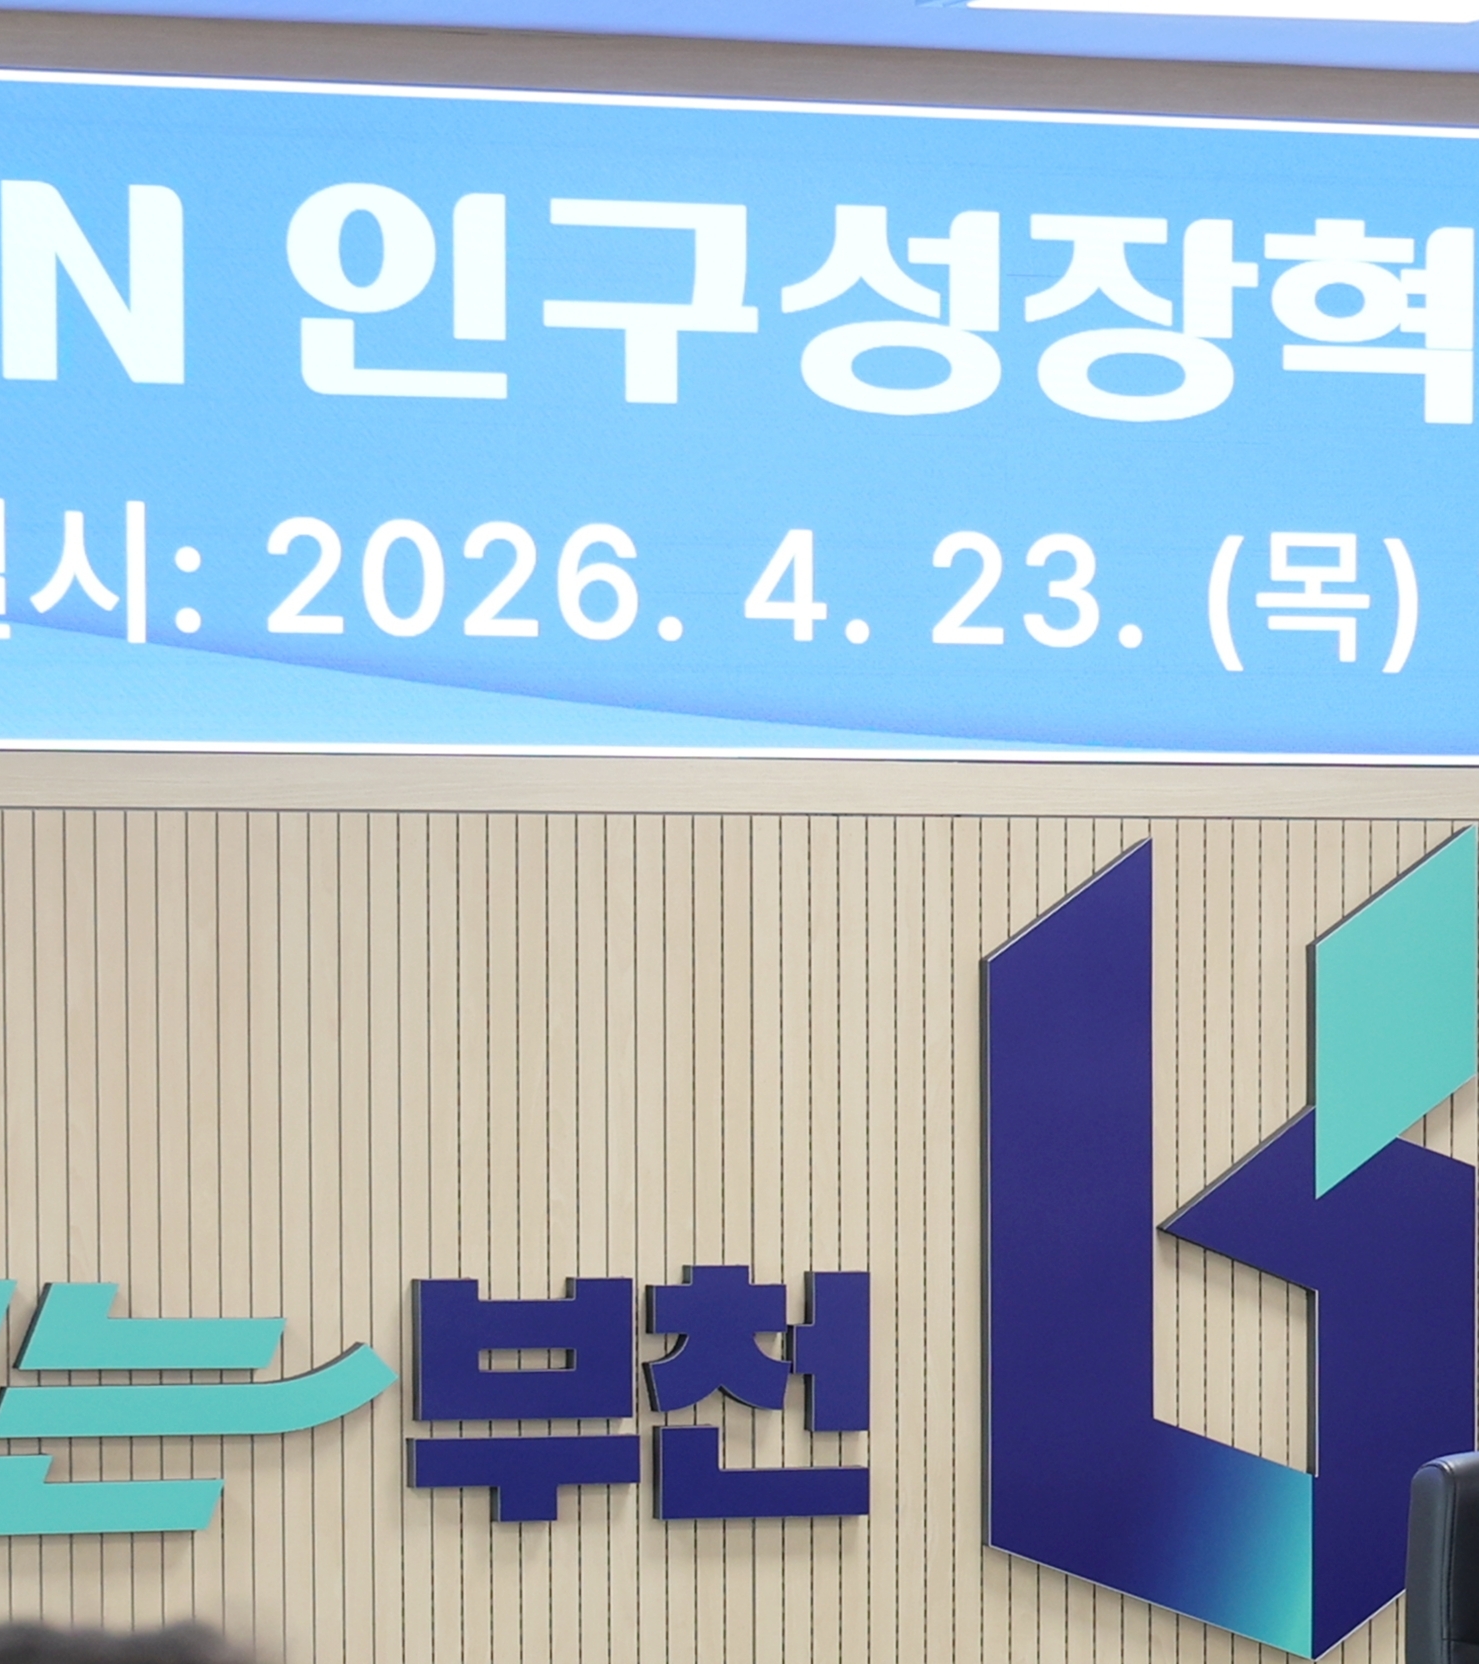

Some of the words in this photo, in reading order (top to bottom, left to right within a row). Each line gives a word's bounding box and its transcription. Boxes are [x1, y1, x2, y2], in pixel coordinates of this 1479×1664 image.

[266, 516, 684, 642] 2026.
[743, 528, 871, 645] 4.
[931, 530, 1144, 650] 23.
[1207, 530, 1419, 674] (목)
[408, 1265, 871, 1523] 부천
